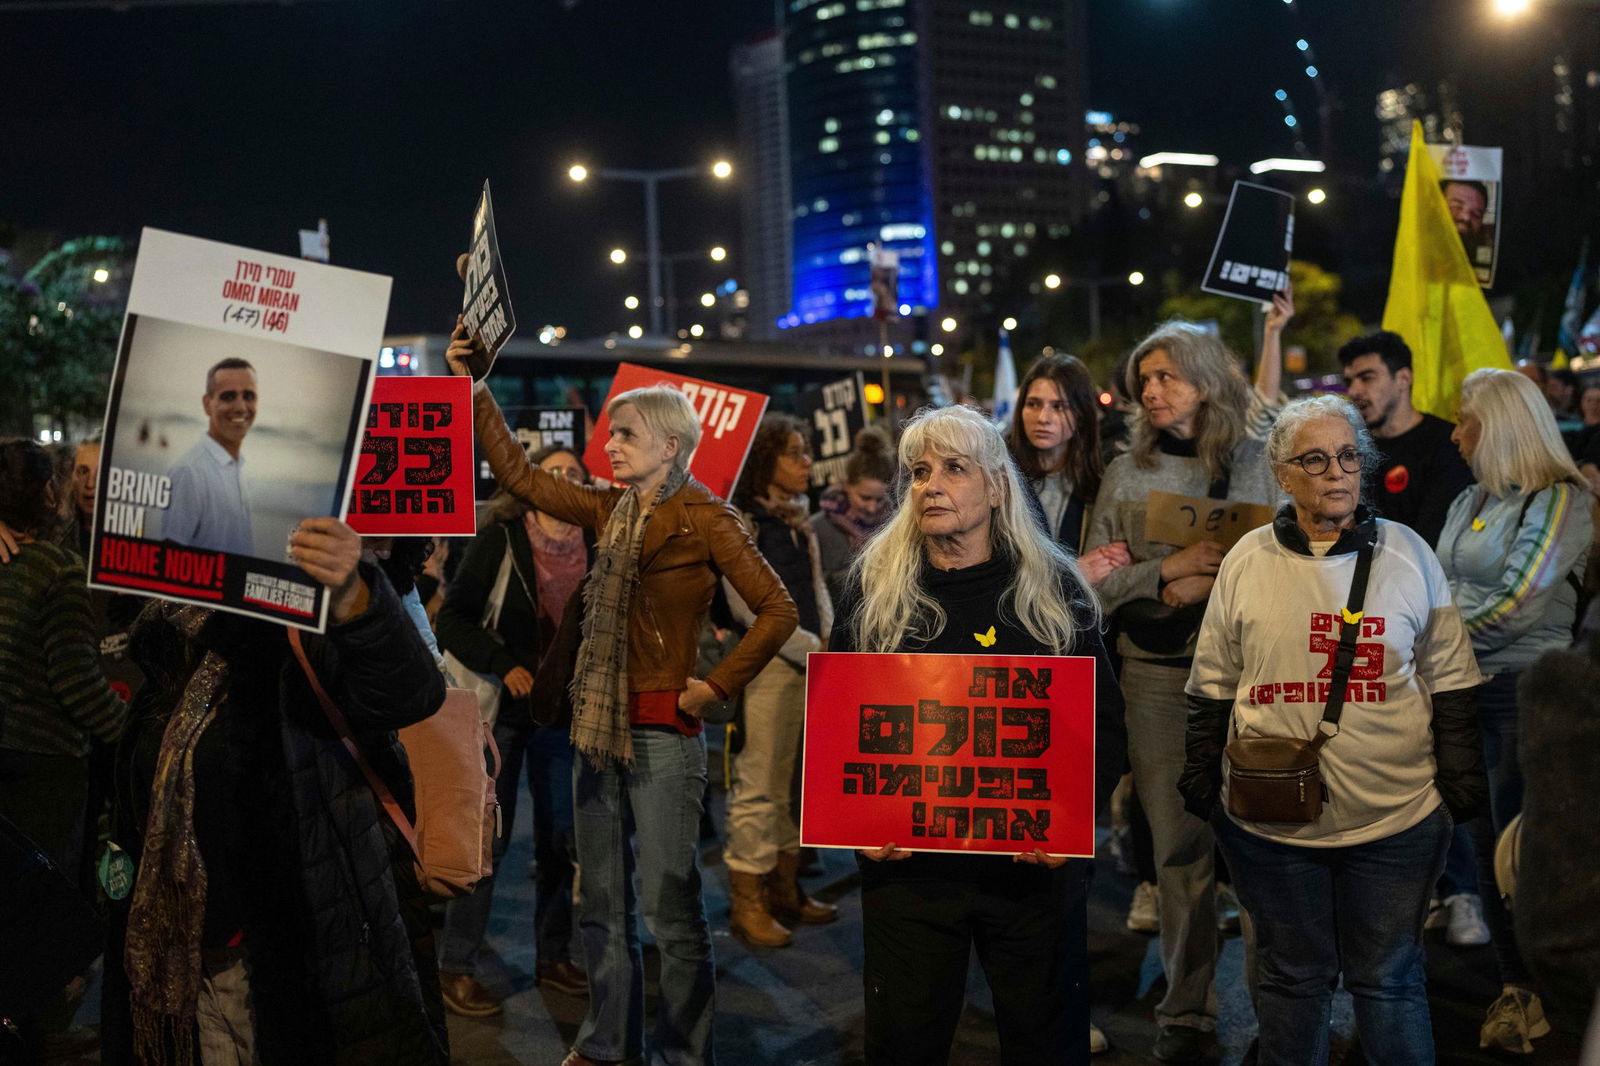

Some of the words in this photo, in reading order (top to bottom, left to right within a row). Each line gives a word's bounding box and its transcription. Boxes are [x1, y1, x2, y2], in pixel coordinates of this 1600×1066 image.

[236, 260, 263, 282] מירן
[266, 266, 296, 289] עמרי
[222, 280, 256, 304] OMRI
[258, 287, 300, 312] MIRAN
[223, 304, 260, 329] (47)
[539, 410, 574, 430] את
[814, 408, 851, 457] כל
[106, 466, 172, 508] BRING
[103, 501, 145, 538] HIM
[100, 537, 161, 576] HOME
[164, 547, 226, 588] NOW!
[1311, 612, 1386, 638] קם
[1309, 633, 1385, 681] כל
[968, 666, 1052, 700] את
[858, 699, 1051, 759] כולם
[843, 762, 1052, 801] בפעימה
[911, 802, 1052, 842] אחת!
